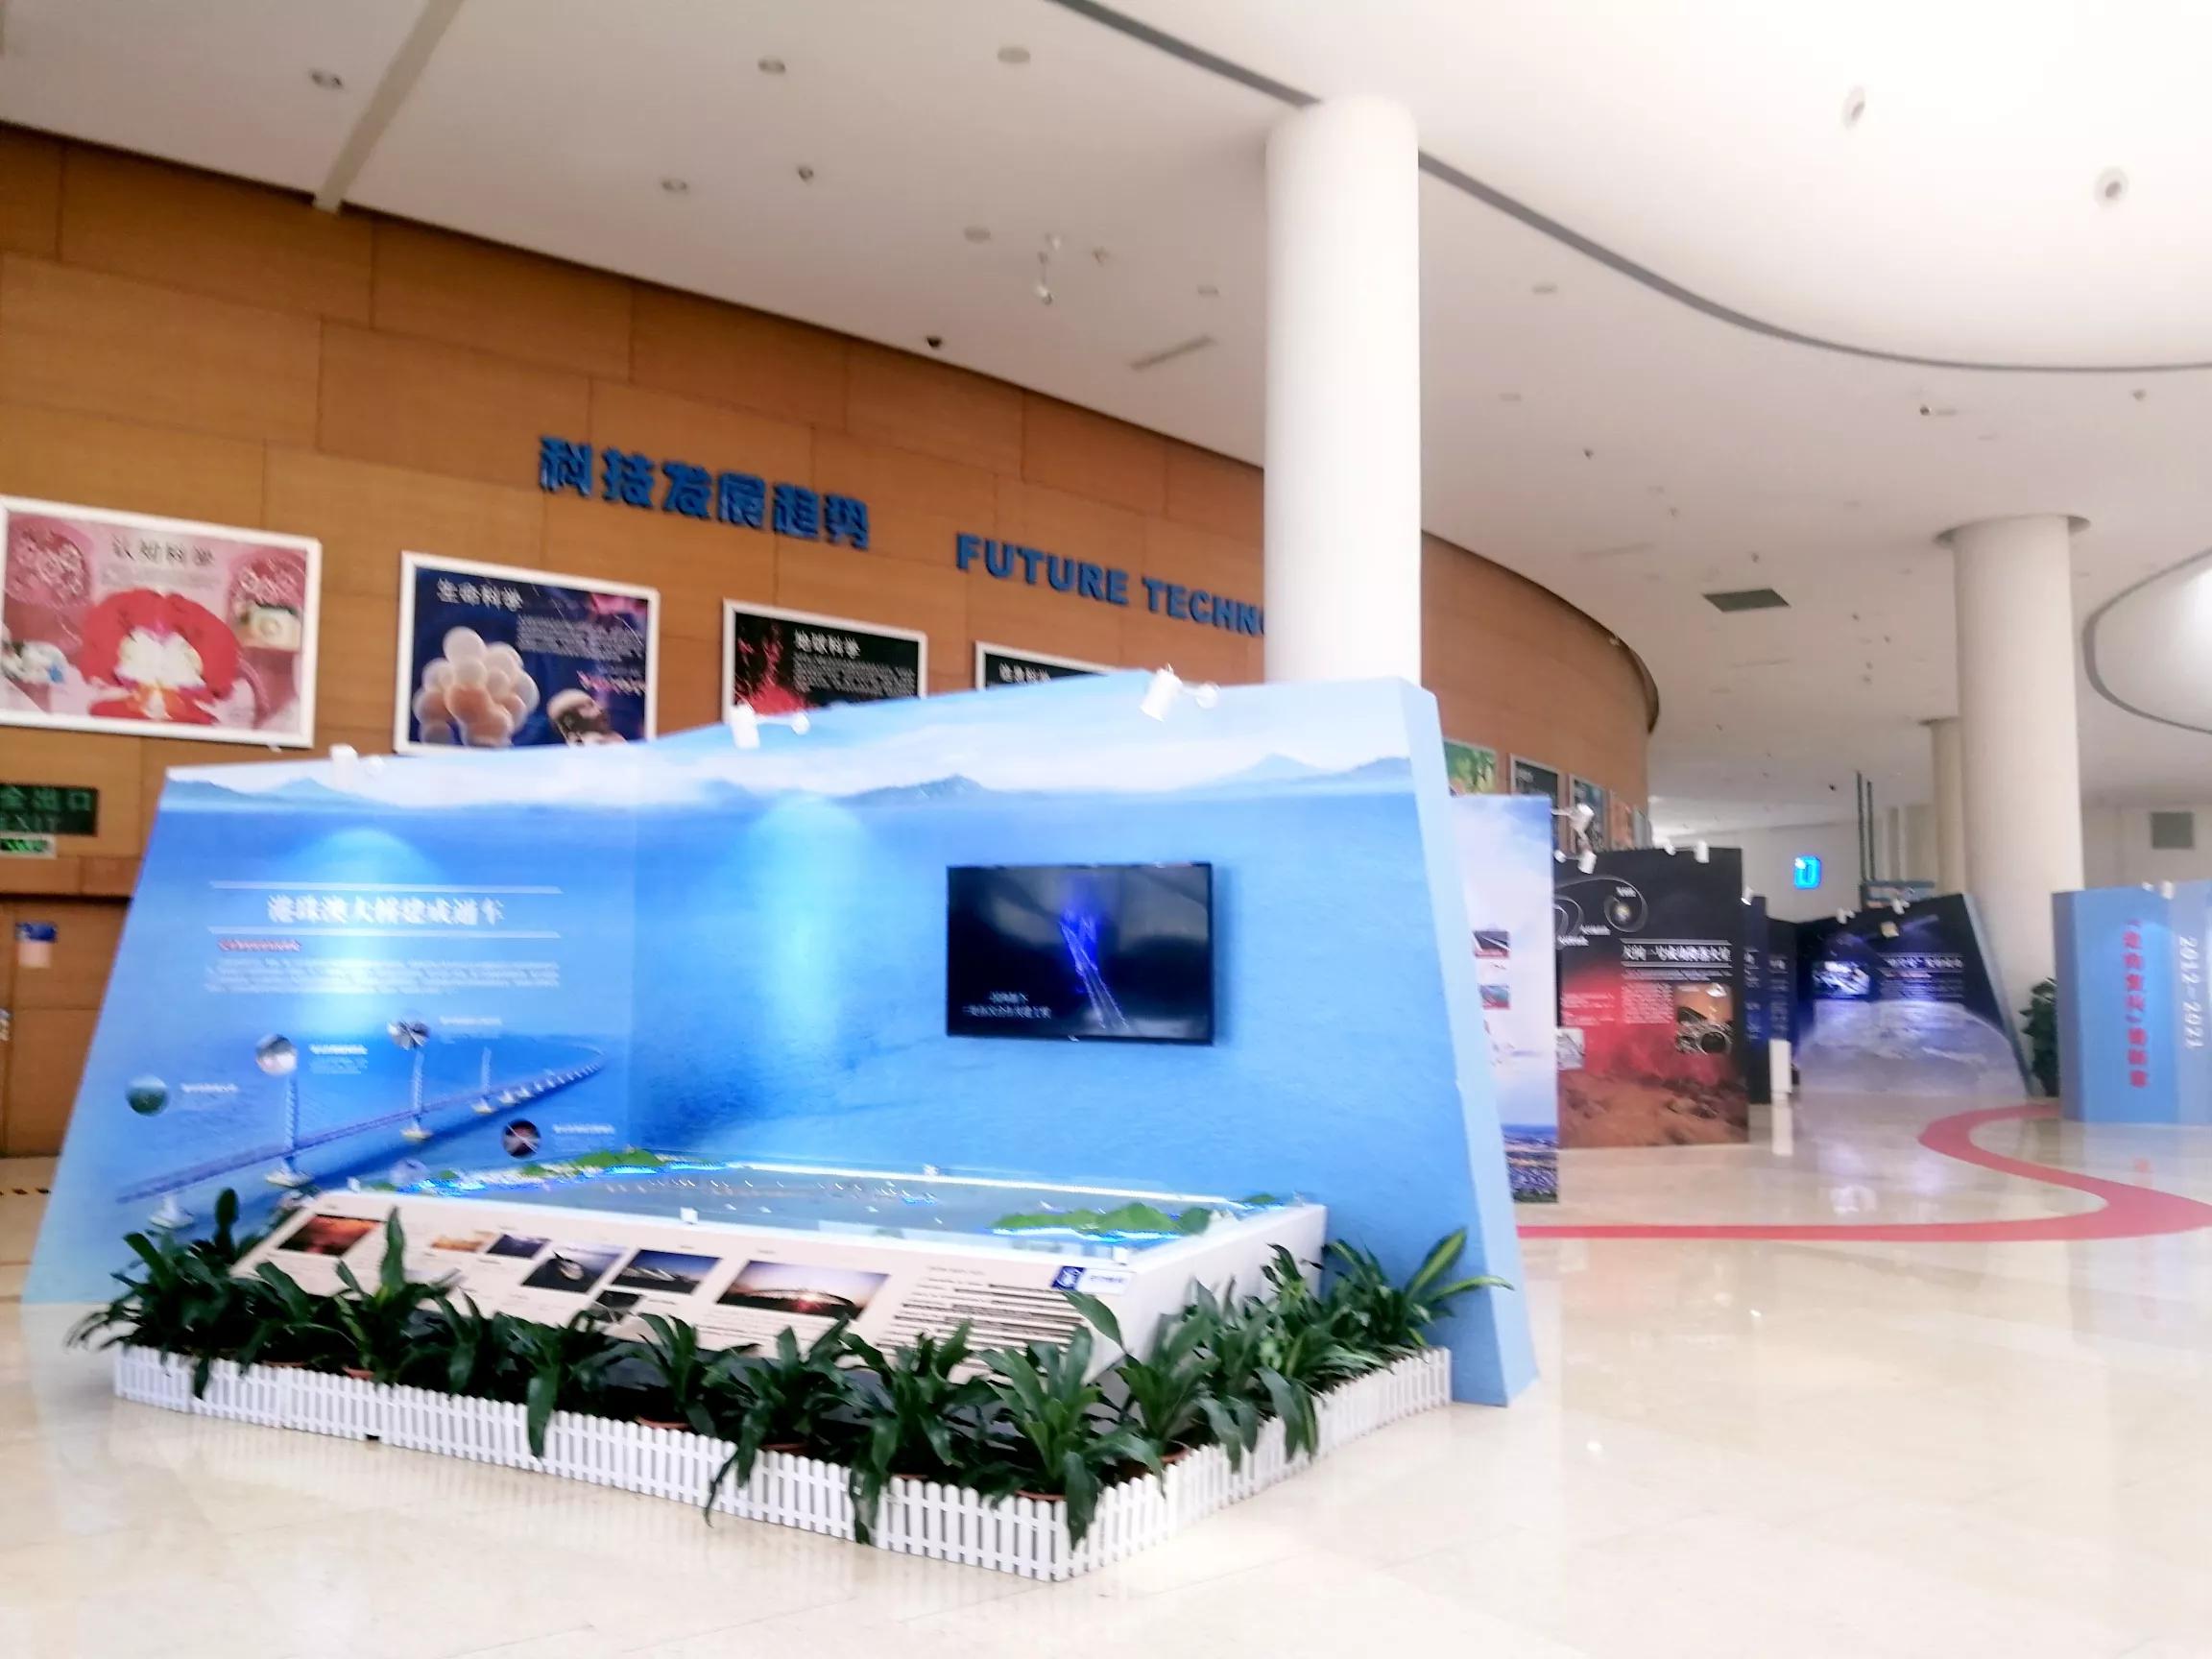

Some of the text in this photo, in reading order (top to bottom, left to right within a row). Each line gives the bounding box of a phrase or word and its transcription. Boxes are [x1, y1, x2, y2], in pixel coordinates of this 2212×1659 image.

[540, 435, 869, 551] 科技发展趋势
[437, 578, 522, 612] 生命科学
[956, 532, 1129, 607] FUTURE
[268, 894, 506, 926] 港珠澳大桥建成通车
